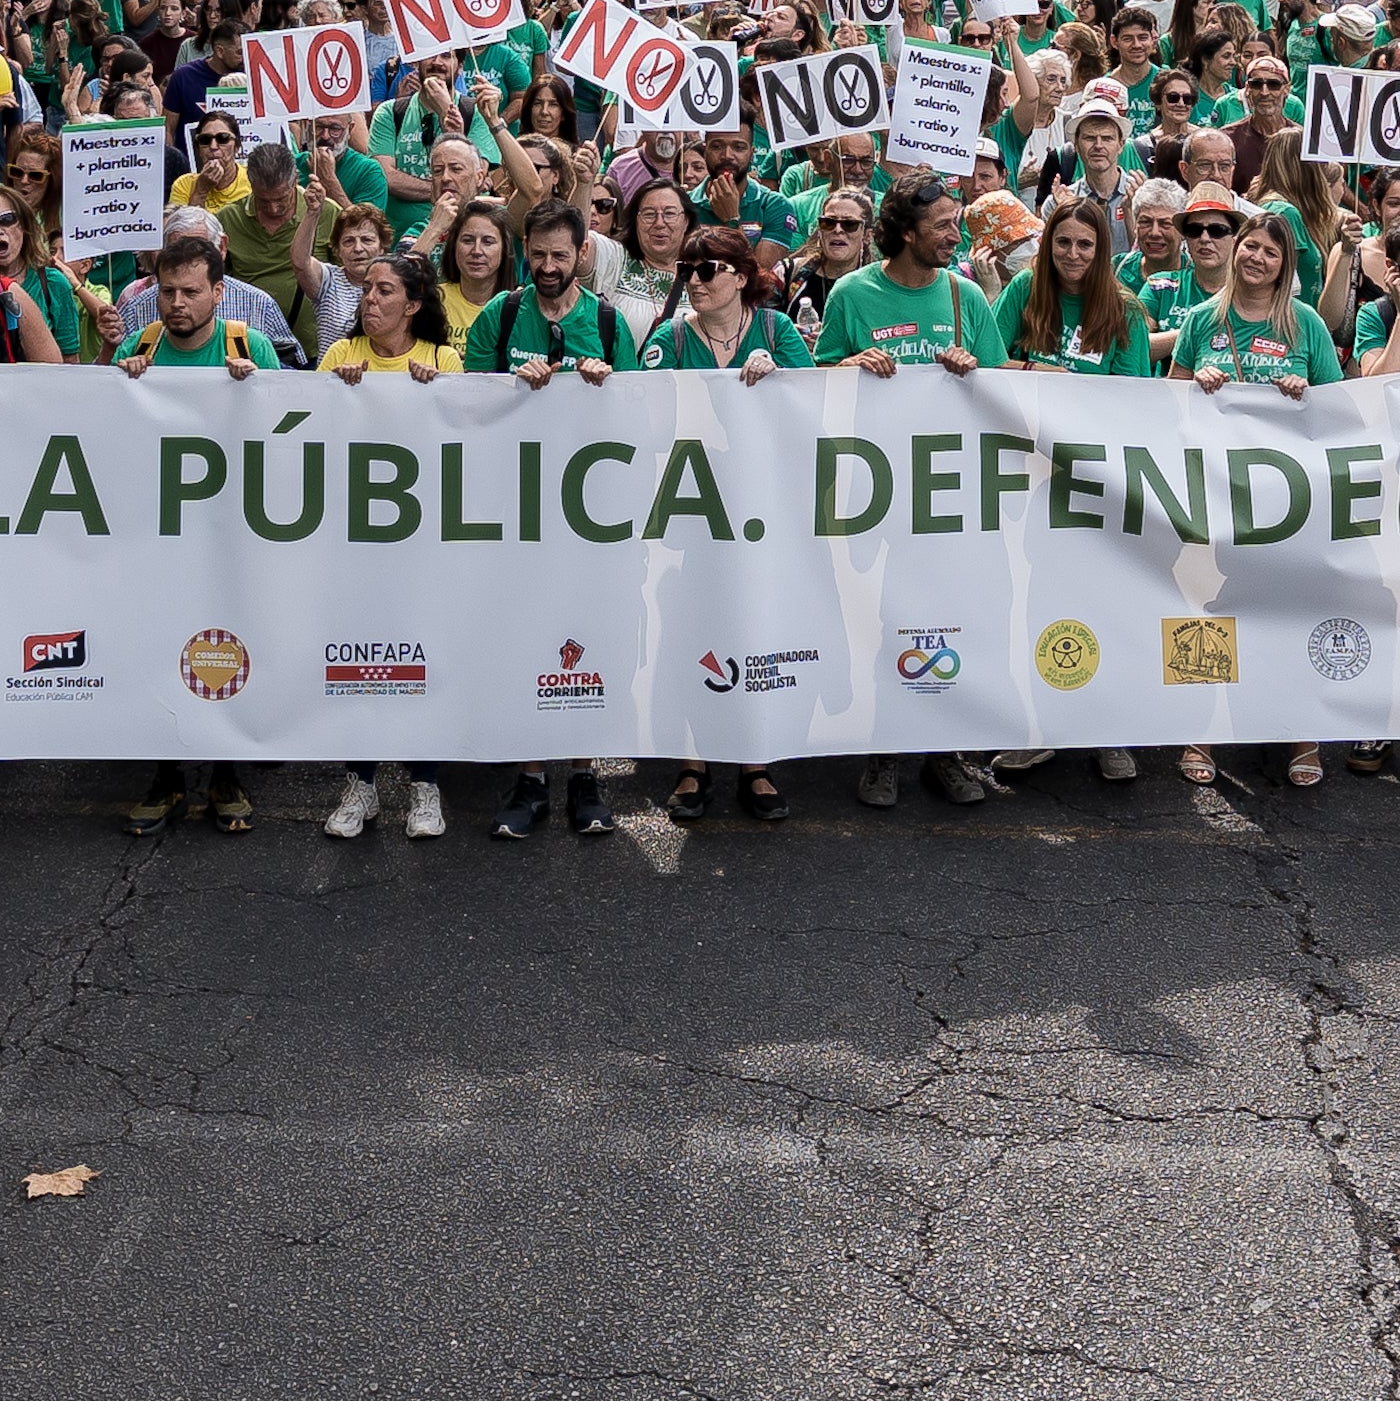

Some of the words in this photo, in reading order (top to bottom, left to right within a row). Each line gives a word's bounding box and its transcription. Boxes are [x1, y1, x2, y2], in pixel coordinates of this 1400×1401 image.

[907, 49, 967, 72] Maestros
[967, 64, 982, 75] x:
[248, 25, 362, 119] NO
[919, 75, 975, 97] plantilla,
[211, 97, 249, 108] Maestr
[760, 52, 881, 143] NO
[913, 96, 961, 116] salario,
[917, 117, 947, 134] ratio
[949, 125, 960, 138] y
[69, 136, 139, 152] Maestros
[140, 136, 155, 147] x:
[893, 132, 971, 159] -burocracia.
[87, 156, 152, 175] plantilla,
[83, 178, 139, 195] salario,
[92, 200, 128, 216] ratio
[130, 203, 140, 216] y
[68, 222, 157, 242] -burocracia.
[872, 327, 893, 340] UGT
[1253, 338, 1286, 352] CCOO
[160, 411, 767, 542] PÚBLICA.
[1171, 621, 1202, 638] FAMILIAS
[911, 635, 948, 649] TEA
[31, 640, 78, 662] CNT
[194, 650, 236, 660] COMEDOR
[324, 642, 426, 664] CONFAPA
[744, 650, 820, 669] COORDINADORA
[5, 676, 55, 689] Sección
[55, 675, 104, 688] Sindical
[537, 672, 603, 688] CONTRA
[744, 666, 781, 681] JUVENIL
[537, 686, 605, 698] CORRIENTE
[744, 676, 798, 693] SOCIALISTA
[5, 692, 45, 702] Educación
[45, 691, 74, 702] Pública
[74, 692, 94, 701] CAM
